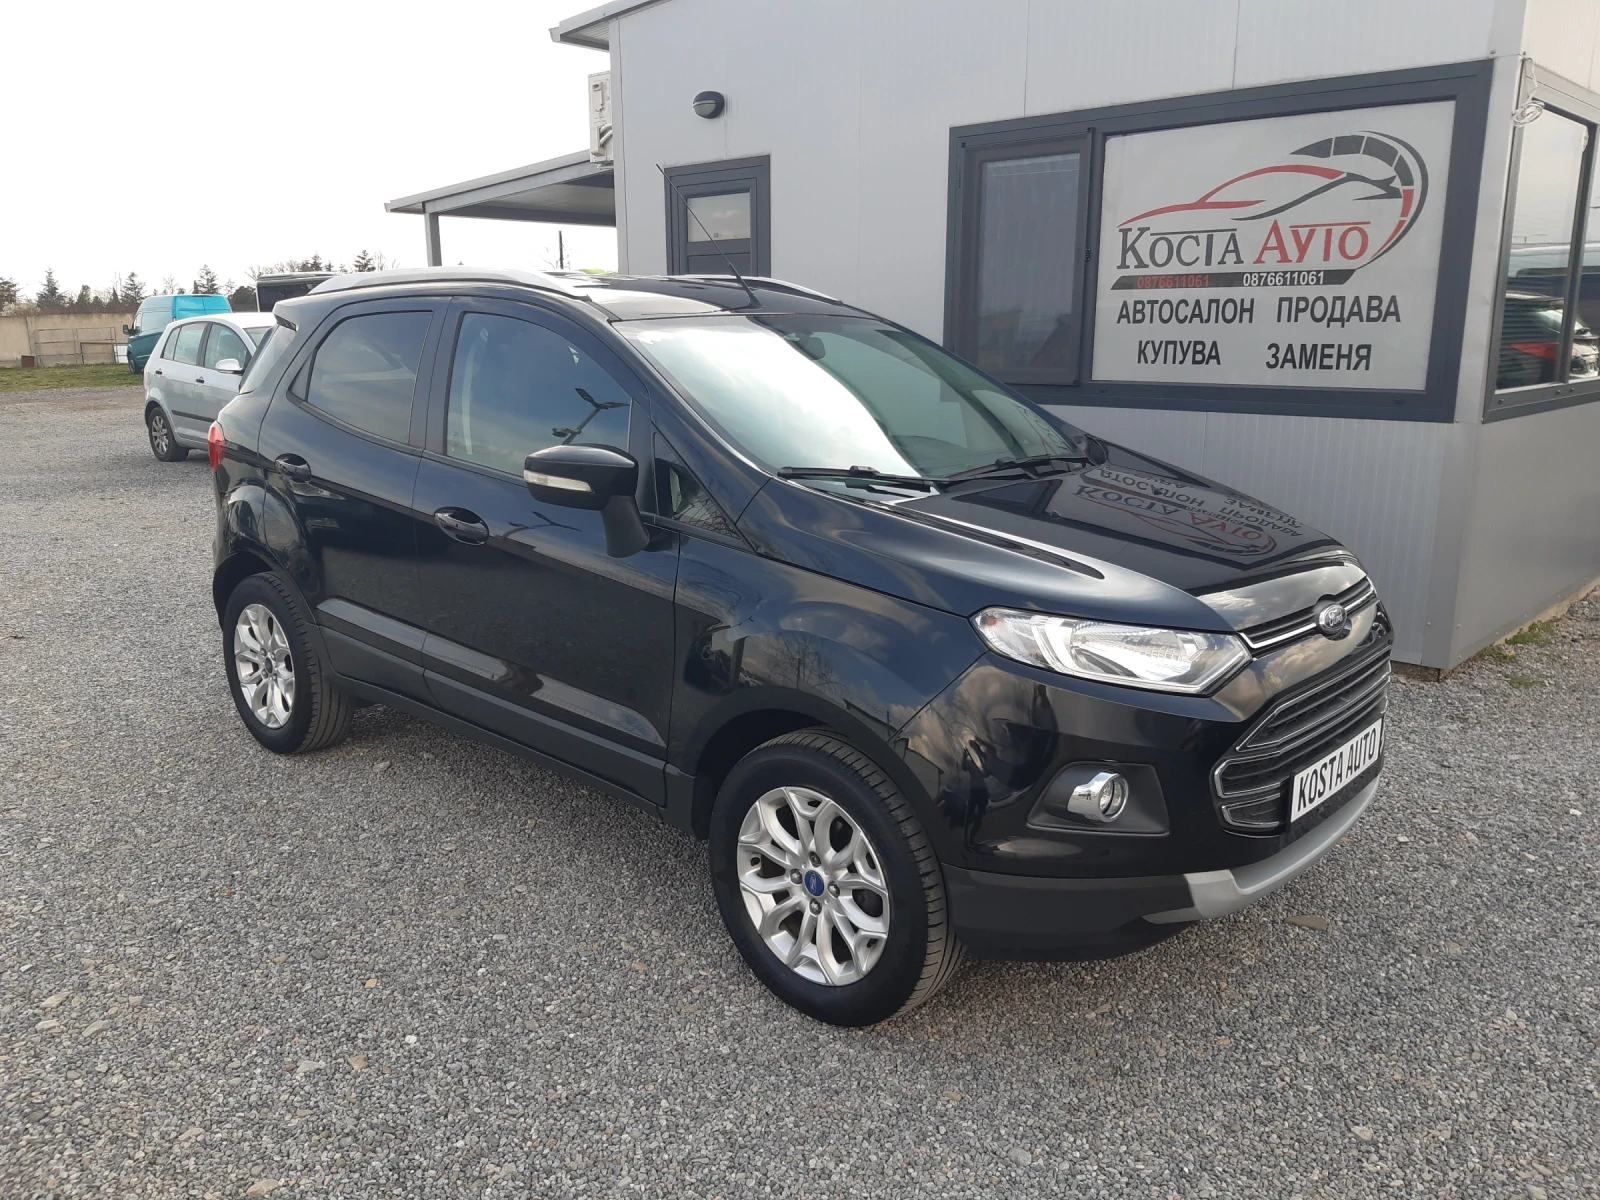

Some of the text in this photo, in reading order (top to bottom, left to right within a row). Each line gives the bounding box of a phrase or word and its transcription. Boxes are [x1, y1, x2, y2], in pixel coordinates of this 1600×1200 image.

[1136, 275, 1210, 289] 0876611061
[1243, 271, 1324, 286] 0876611061
[1116, 295, 1401, 328] АВТОСАЛОН ПРОДАВА
[1137, 340, 1372, 370] КУПУВА ЗАМЕНЯ
[1297, 727, 1377, 812] KOSTA AUTO
